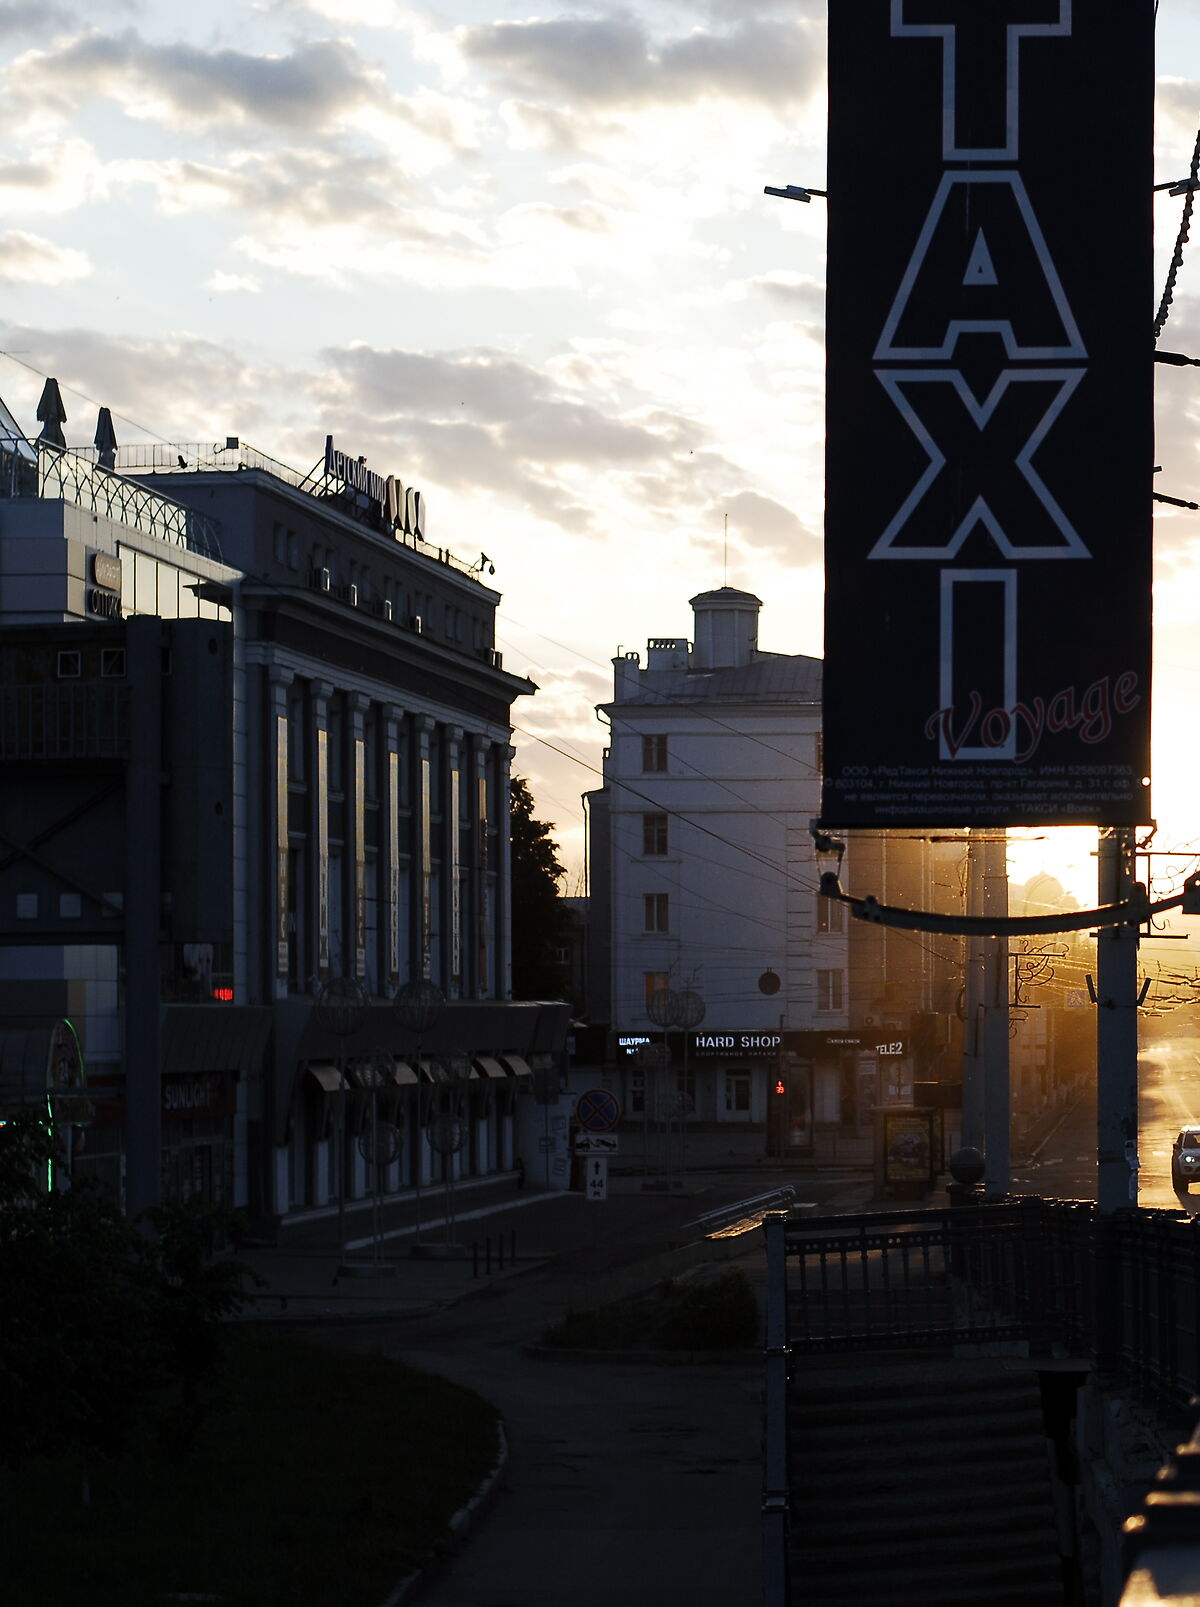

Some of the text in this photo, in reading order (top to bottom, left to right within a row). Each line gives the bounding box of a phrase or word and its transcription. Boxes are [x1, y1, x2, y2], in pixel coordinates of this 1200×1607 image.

[924, 671, 1141, 764] Voyage
[842, 766, 869, 776] ООО
[1040, 765, 1065, 775] ИНН
[695, 1036, 781, 1048] HARD SHOP
[875, 1041, 903, 1055] TELE2
[590, 1179, 604, 1188] 44
